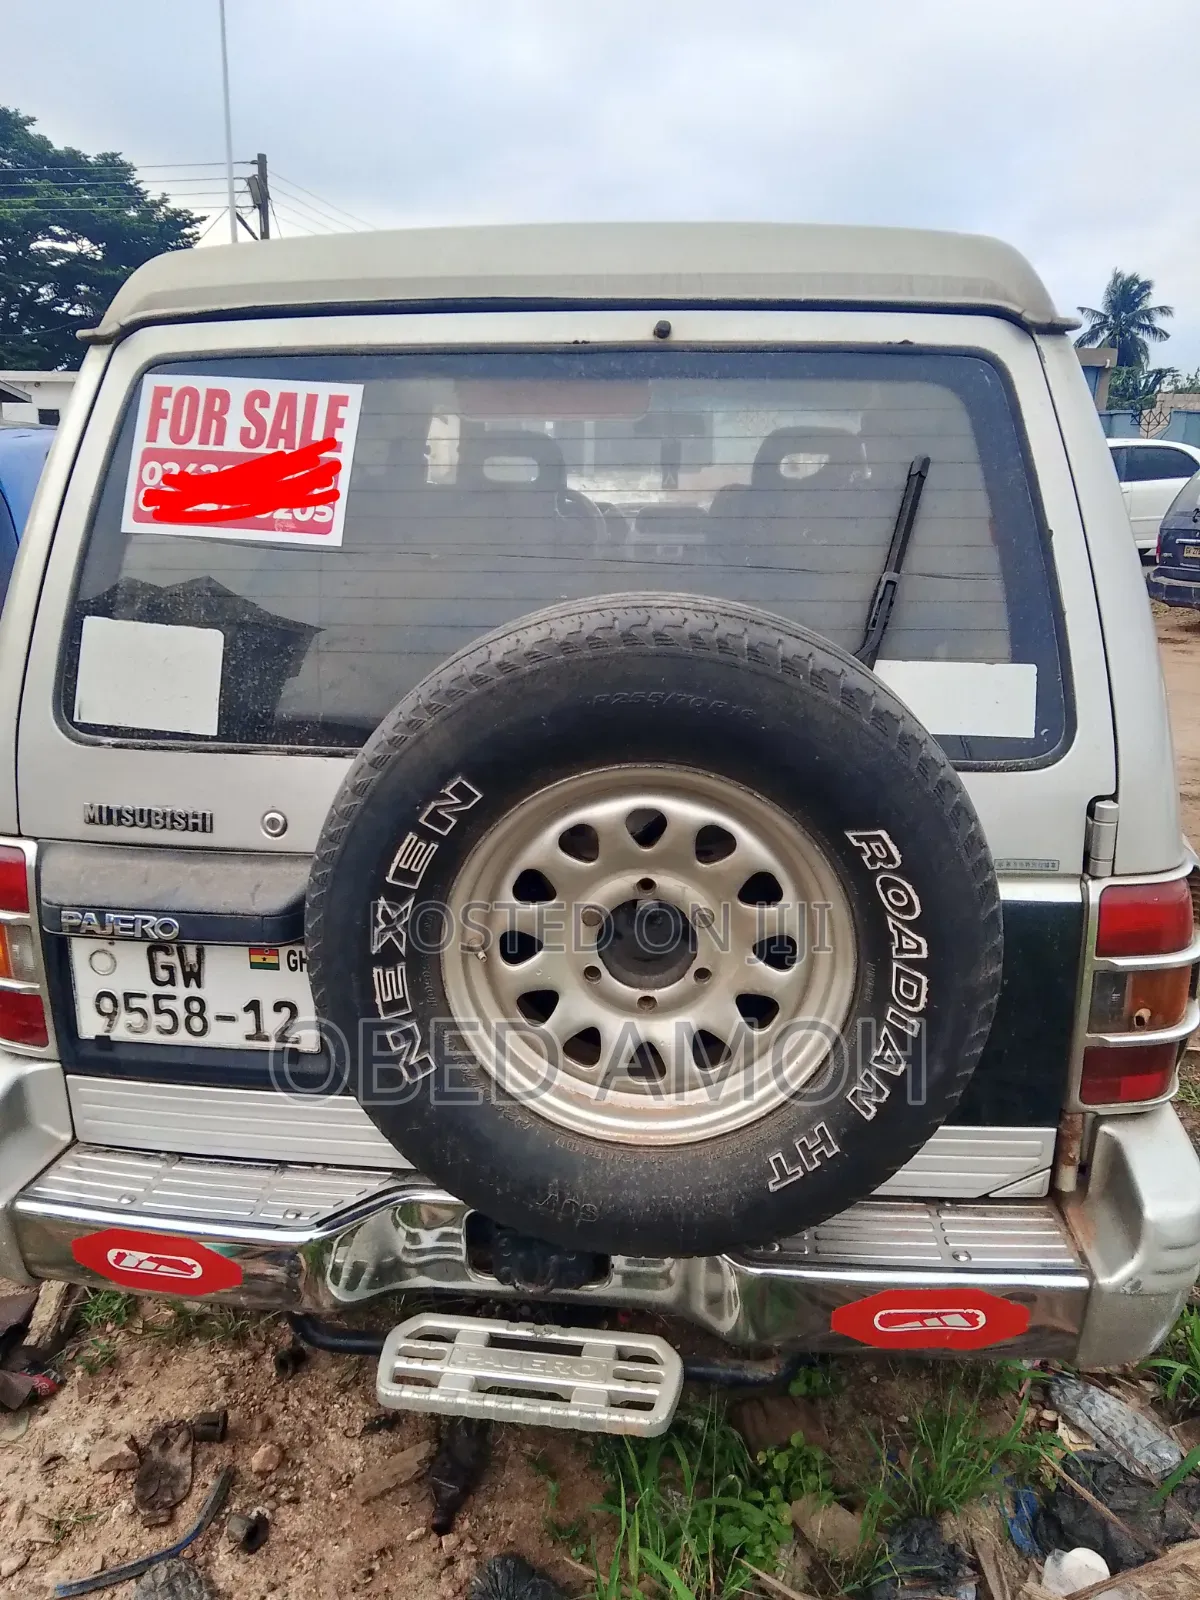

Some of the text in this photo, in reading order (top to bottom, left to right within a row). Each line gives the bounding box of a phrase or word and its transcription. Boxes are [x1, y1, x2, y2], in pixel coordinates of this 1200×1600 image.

[145, 385, 349, 454] FOR SALE
[83, 802, 214, 833] MITSUBISHI
[60, 909, 180, 941] PAJERO
[371, 775, 484, 1085] NEXEN
[147, 943, 206, 989] GW
[844, 828, 929, 1122] ROADIAN
[94, 989, 302, 1044] 9558-12
[767, 1121, 841, 1193] HT
